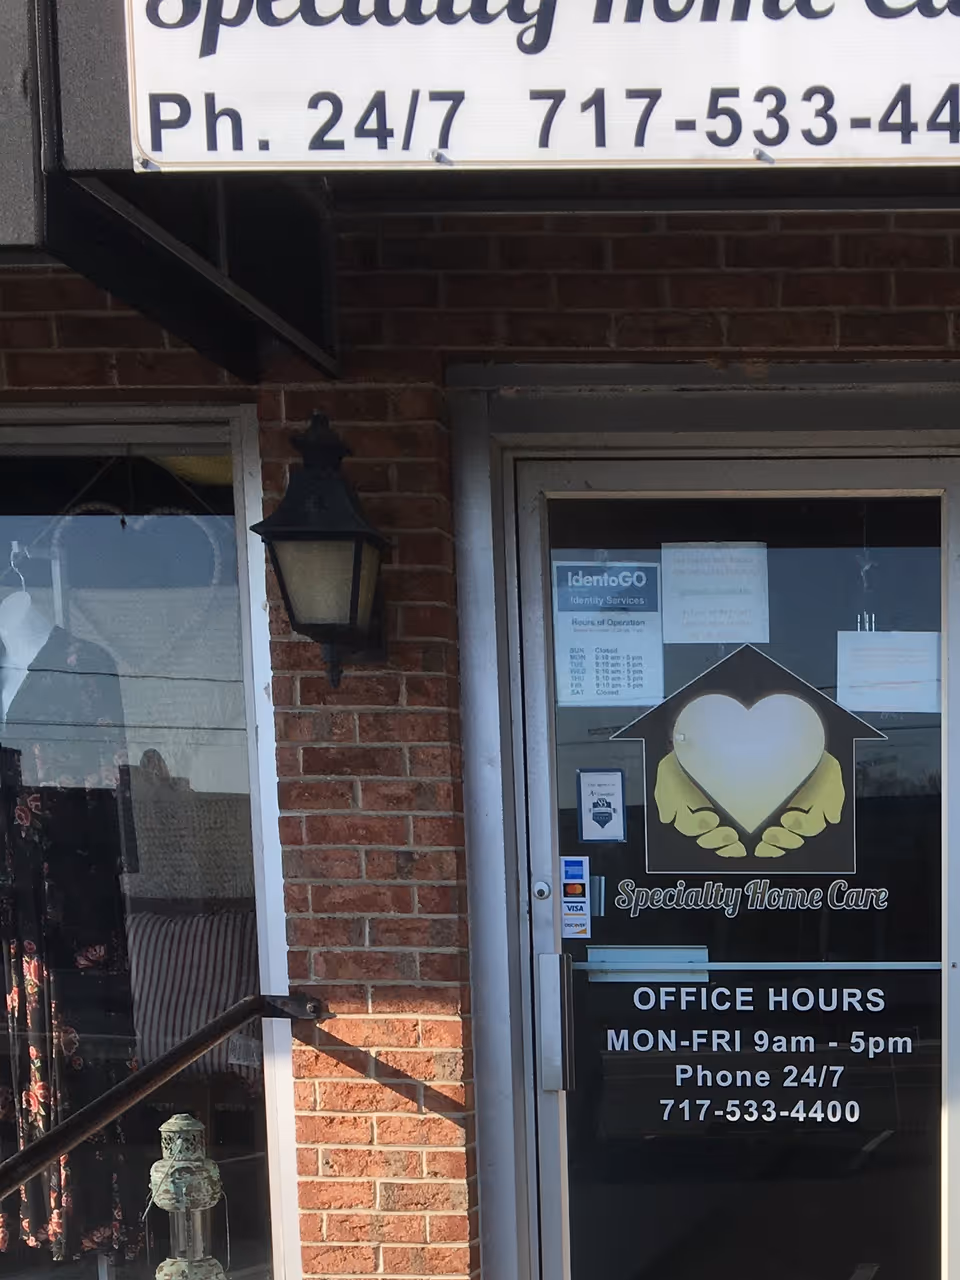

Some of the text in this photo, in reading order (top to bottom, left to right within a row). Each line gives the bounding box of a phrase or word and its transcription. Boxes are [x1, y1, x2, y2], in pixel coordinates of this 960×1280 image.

[148, 92, 270, 151] Ph.
[307, 89, 466, 151] 24/7
[567, 570, 647, 588] IdentoGO
[570, 595, 645, 606] Identity Services
[571, 618, 646, 628] Hours of Operation
[566, 904, 584, 912] VISA
[615, 879, 889, 918] Specialty Home Care
[633, 986, 886, 1012] OFFICE HOURS
[607, 1029, 741, 1052] MON-FRI
[753, 1030, 815, 1053] 9am
[850, 1031, 912, 1059] 5pm
[675, 1064, 845, 1088] Phone 24/7
[660, 1099, 860, 1123] 717-533-4400
